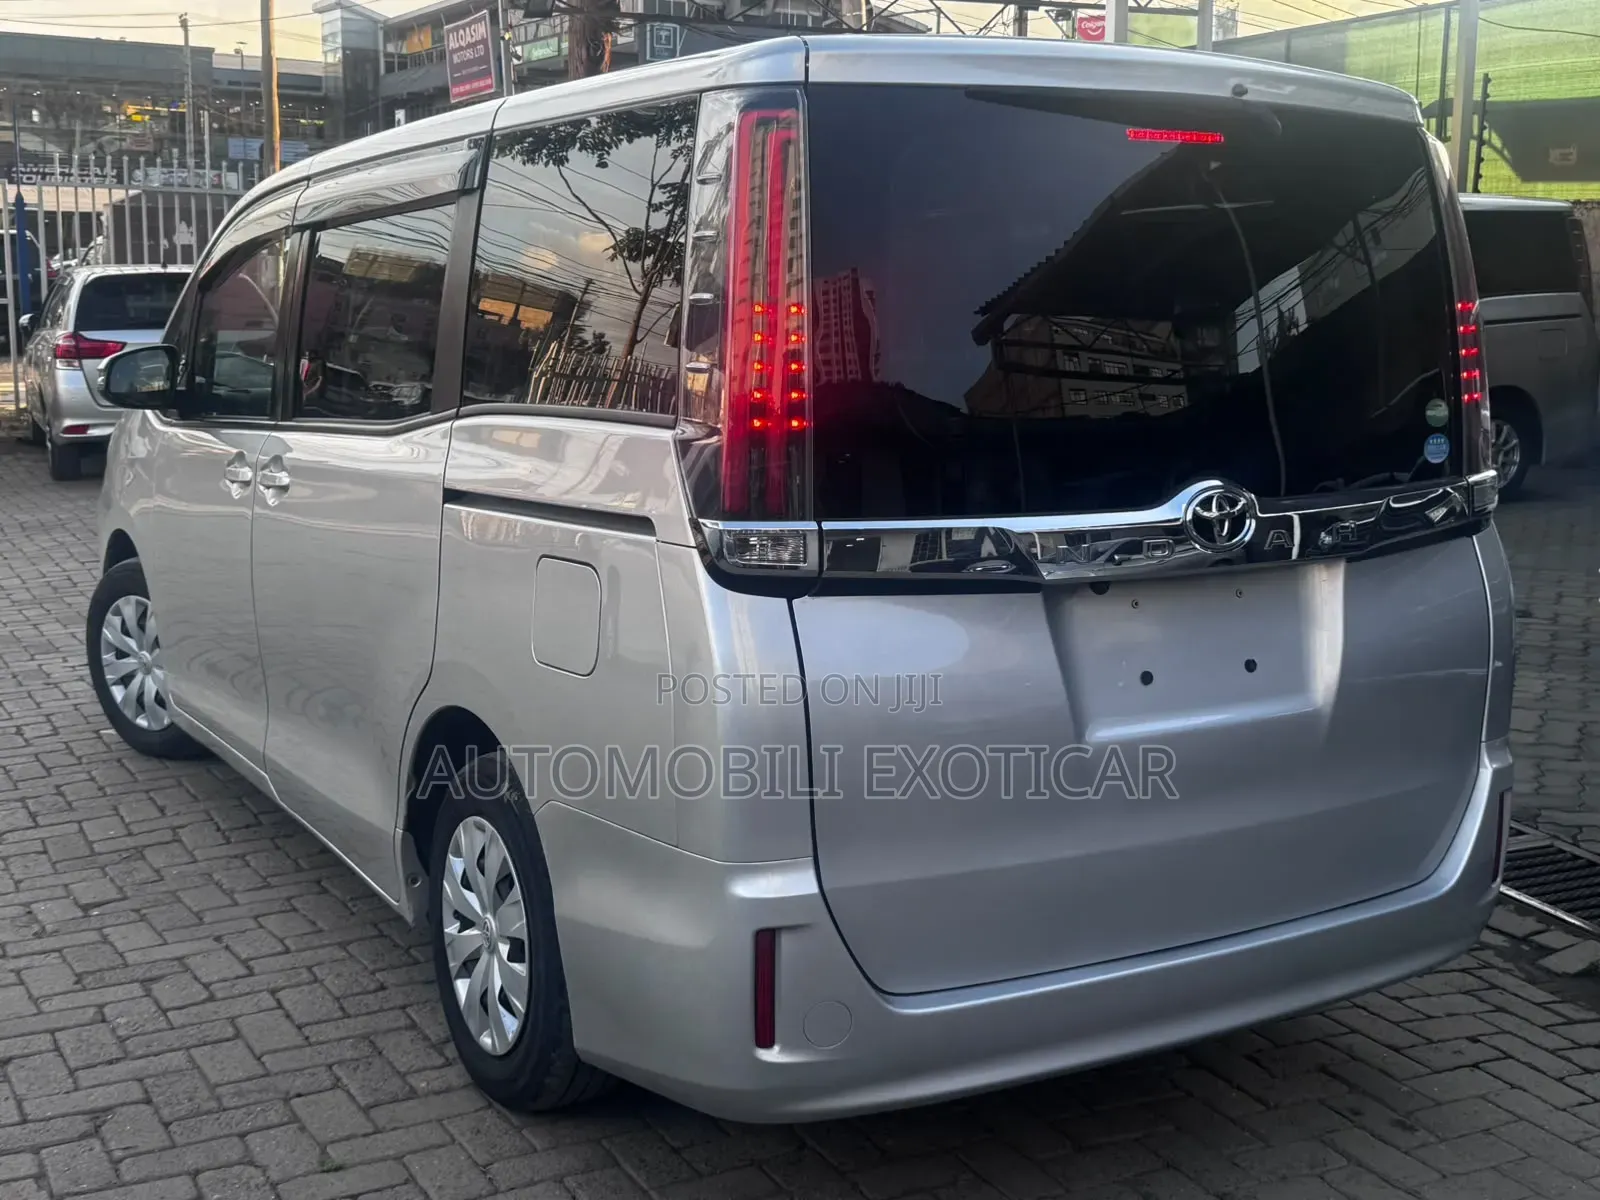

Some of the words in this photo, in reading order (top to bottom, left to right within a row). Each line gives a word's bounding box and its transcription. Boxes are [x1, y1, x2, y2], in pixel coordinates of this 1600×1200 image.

[448, 20, 487, 51] ALQASIM
[452, 48, 474, 65] MOTORS
[474, 44, 485, 59] LTD
